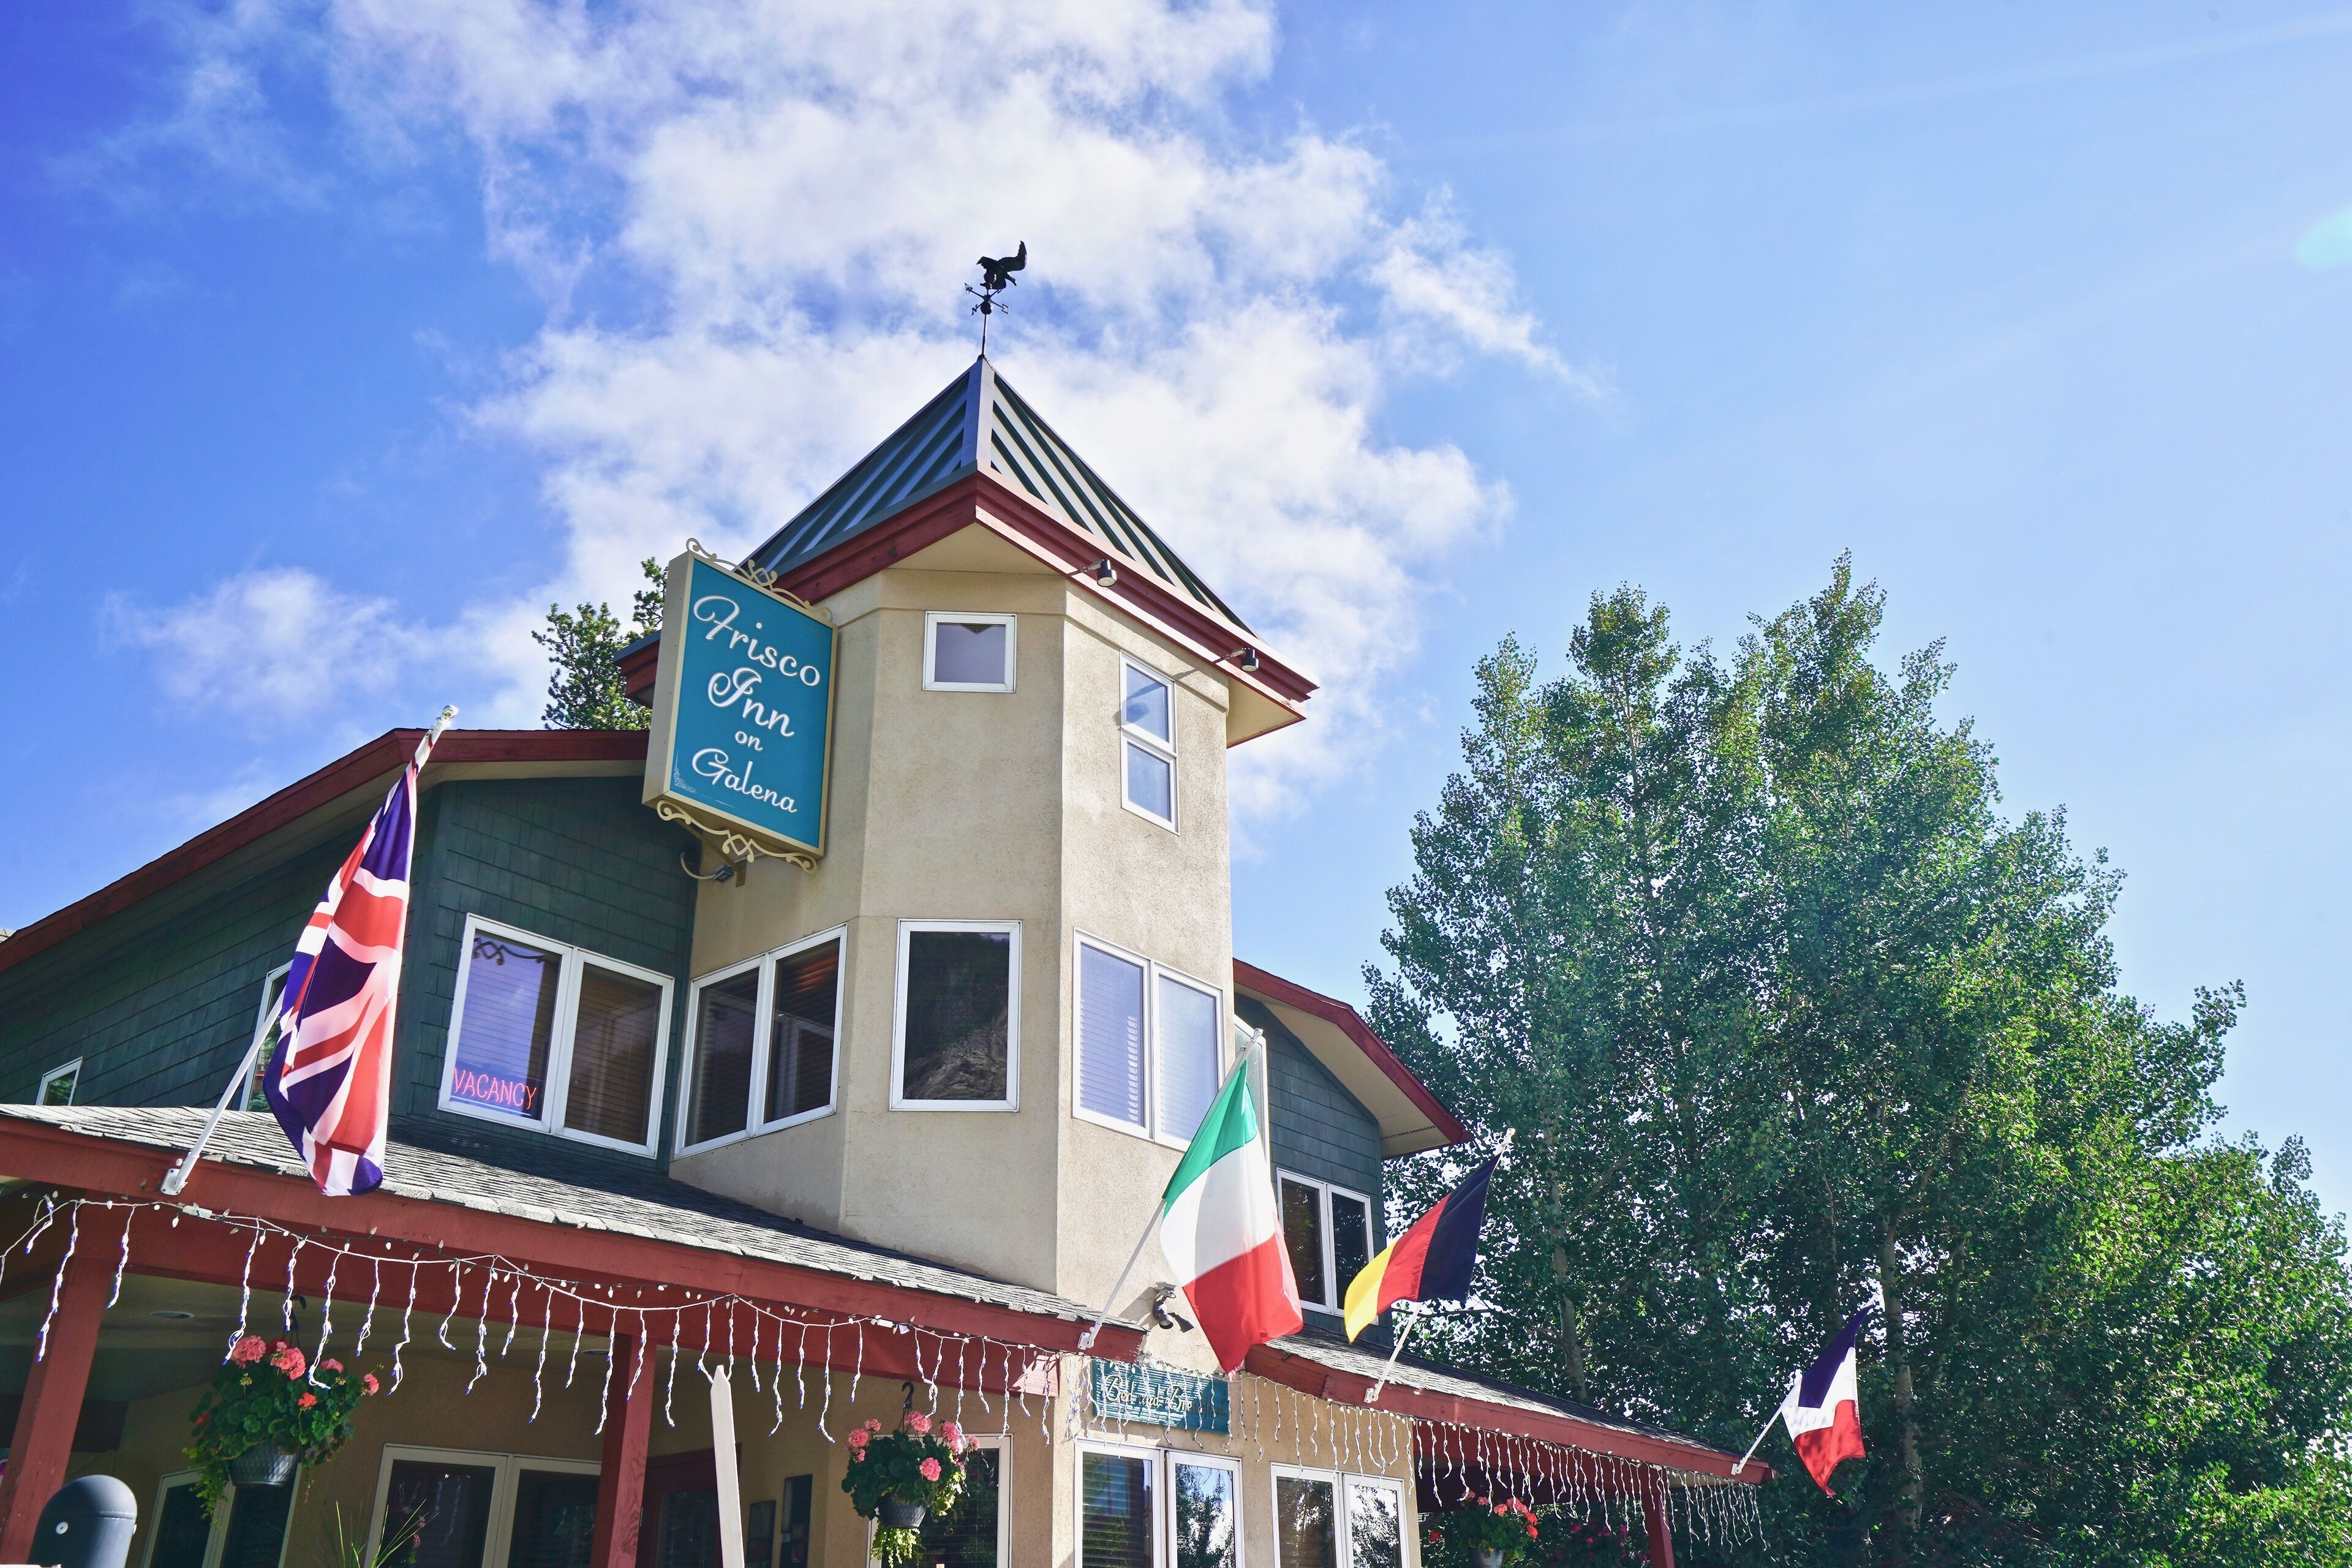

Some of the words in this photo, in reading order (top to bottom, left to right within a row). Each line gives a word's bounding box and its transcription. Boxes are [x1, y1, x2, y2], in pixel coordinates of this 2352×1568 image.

[693, 594, 821, 687] Frisco
[707, 666, 795, 737] Inn
[734, 730, 764, 752] on
[691, 747, 798, 814] Galena
[453, 1067, 538, 1110] VACANCY
[1105, 1374, 1134, 1404] Bed
